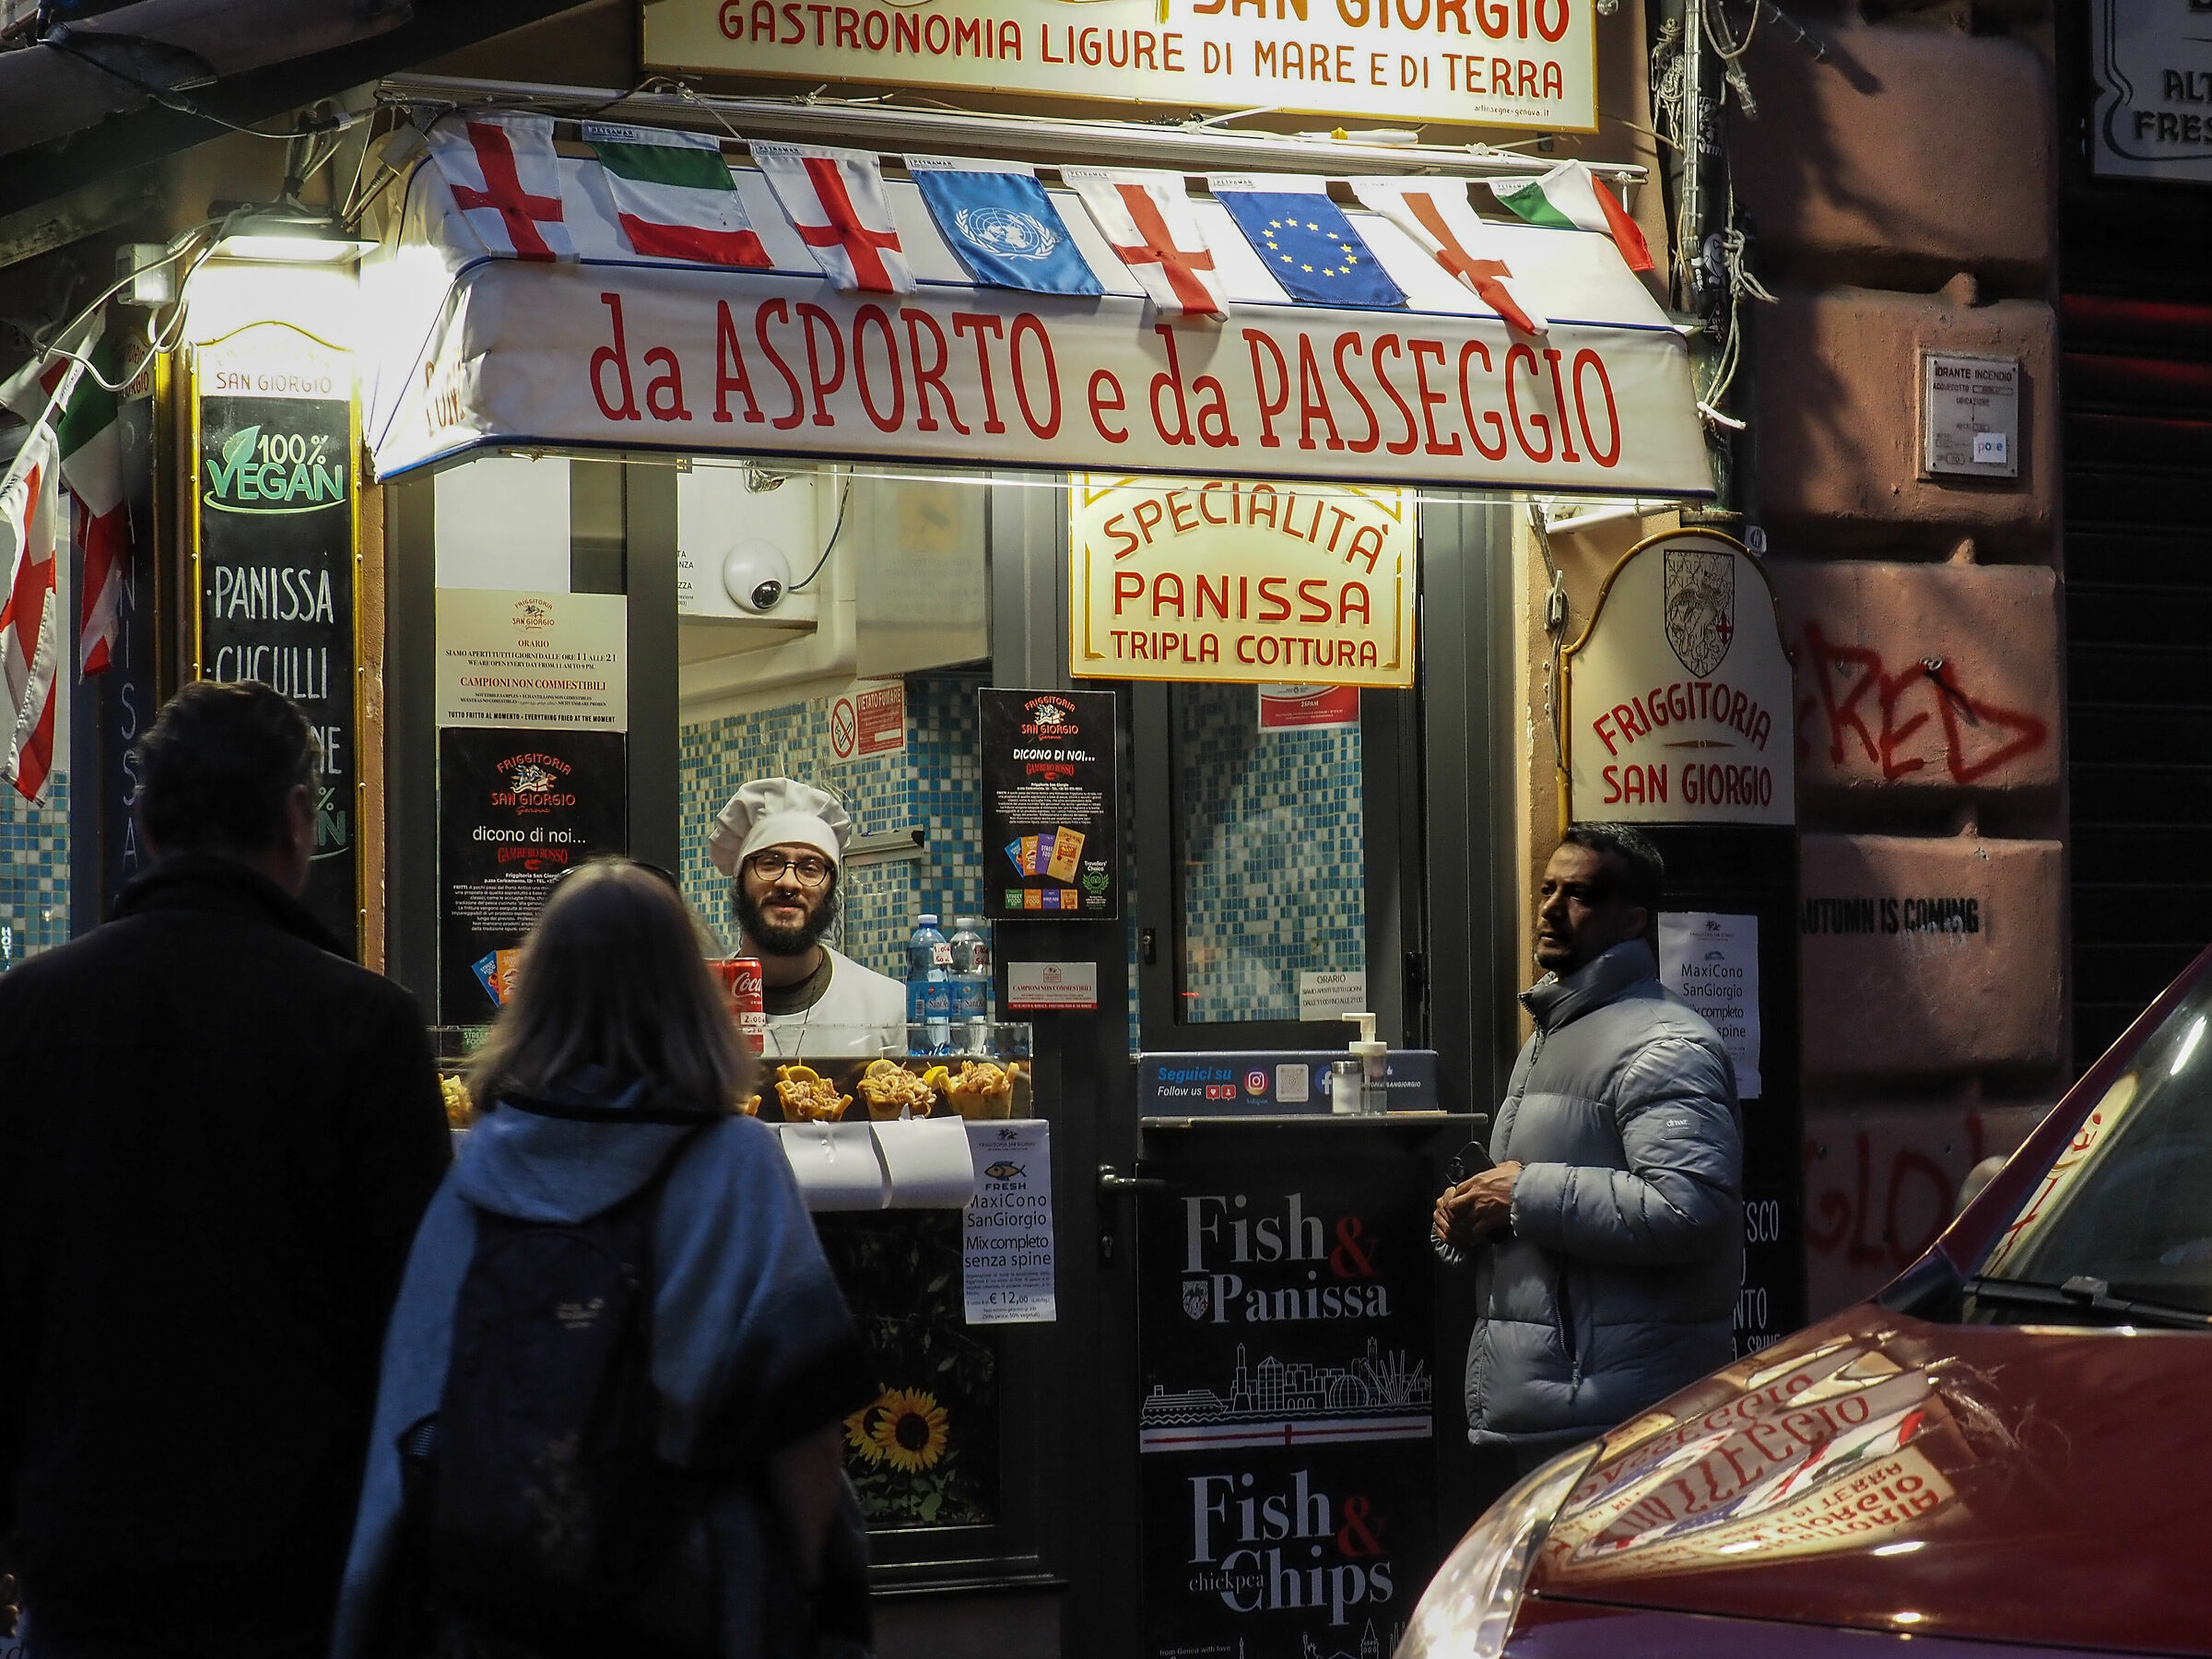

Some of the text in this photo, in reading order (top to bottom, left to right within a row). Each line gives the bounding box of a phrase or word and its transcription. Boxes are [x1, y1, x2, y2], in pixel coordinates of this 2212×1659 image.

[718, 0, 1564, 101] GASTRONOMIA LIGURE DI MARE E DI TERRA
[216, 372, 332, 394] SAN GIORGIO
[590, 291, 692, 422] da
[713, 297, 1062, 441] ASPORTO
[1088, 369, 1130, 444] e
[1149, 324, 1241, 449] da
[1241, 327, 1622, 469] PASSEGGIO
[1974, 370, 2013, 382] INCENDIO
[258, 433, 329, 465] 100%
[206, 460, 344, 501] VEGAN
[216, 566, 334, 624] PANISSA
[1113, 571, 1371, 625] PANISSA
[514, 598, 554, 610] FRIGGITORIA
[518, 640, 549, 648] ORARIO
[1110, 629, 1378, 667] TRIPLA COTTURA
[460, 677, 606, 690] CAMPIONI NON COMMESTIBILI
[1025, 696, 1076, 712] FRIGGITORIA
[466, 712, 485, 720] FRITTO
[494, 712, 520, 721] MOMENTO
[524, 713, 558, 723] EVERYTHING
[1593, 681, 1772, 756] FRIGGITORIA
[1021, 724, 1078, 735] SAN GIORGIO
[1014, 748, 1053, 761] DICONO
[1054, 749, 1065, 762] DI
[496, 753, 572, 776] FRIGGITORIA
[1603, 763, 1772, 807] SAN GIORGIO
[491, 793, 576, 806] SAN GIORGIO
[473, 826, 525, 843] dicono
[530, 828, 544, 843] di
[1880, 899, 1899, 934] IS
[1902, 899, 1980, 935] COMING
[1316, 974, 1347, 984] ORARIO
[1681, 964, 1744, 978] MaxiCono
[1683, 983, 1743, 1000] SanGiorgio
[1701, 1005, 1744, 1021] completo
[1158, 1067, 1232, 1082] Seguici su
[1158, 1085, 1202, 1097] Follow us
[985, 1182, 1027, 1191] FRESH
[968, 1212, 1047, 1230] SanGiorgio
[967, 1234, 1050, 1253] Mix completo
[1182, 1192, 1380, 1279] Fish &
[965, 1253, 1052, 1269] senza spine
[989, 1292, 997, 1304] €
[1001, 1291, 1029, 1305] 12,00
[1209, 1270, 1392, 1324] Panissa
[1188, 1469, 1388, 1565] Fish &
[1219, 1543, 1394, 1627] Chips
[1159, 1648, 1175, 1657] from
[1177, 1646, 1199, 1655] Genoa
